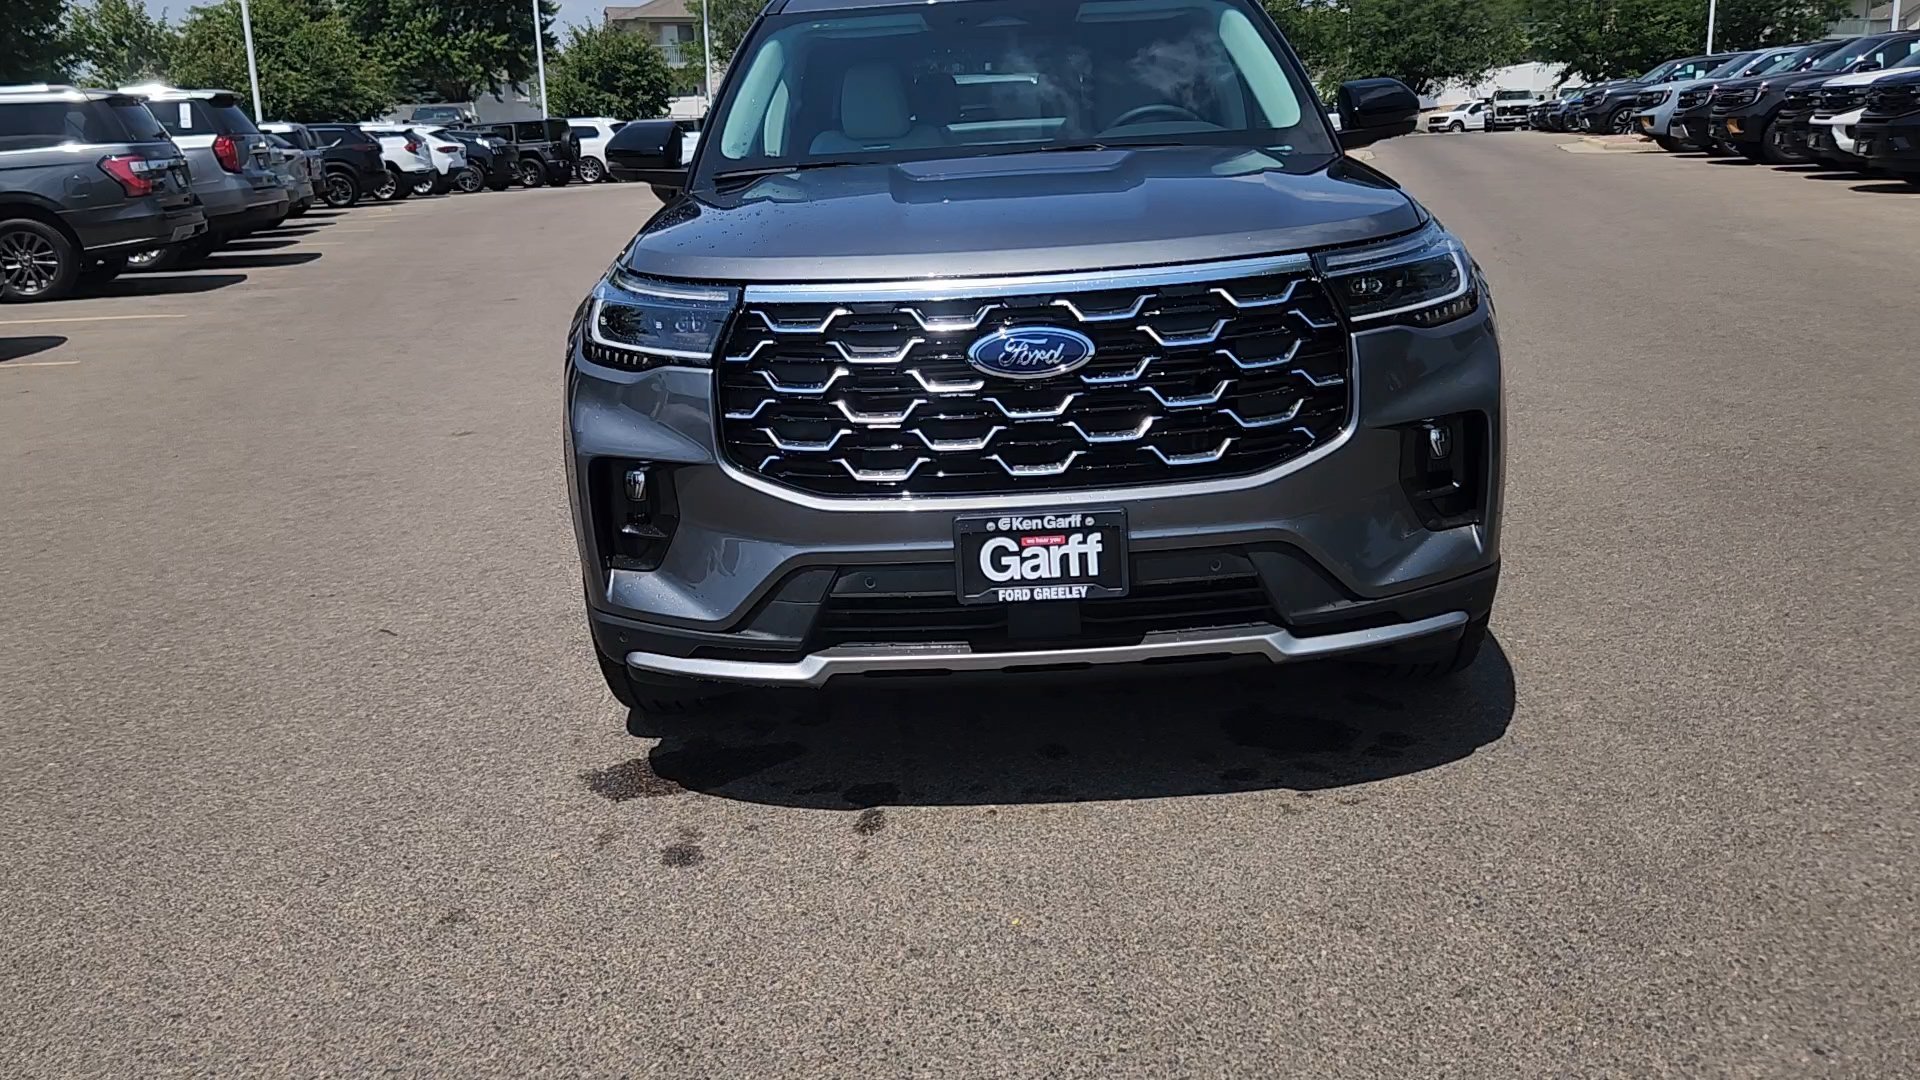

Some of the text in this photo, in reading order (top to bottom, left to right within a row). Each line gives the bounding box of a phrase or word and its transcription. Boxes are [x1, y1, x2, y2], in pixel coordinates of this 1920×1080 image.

[998, 338, 1065, 367] Ford
[1012, 514, 1083, 531] Ken Garff
[979, 532, 1103, 582] Garff
[998, 586, 1088, 602] FORD GREELEY
